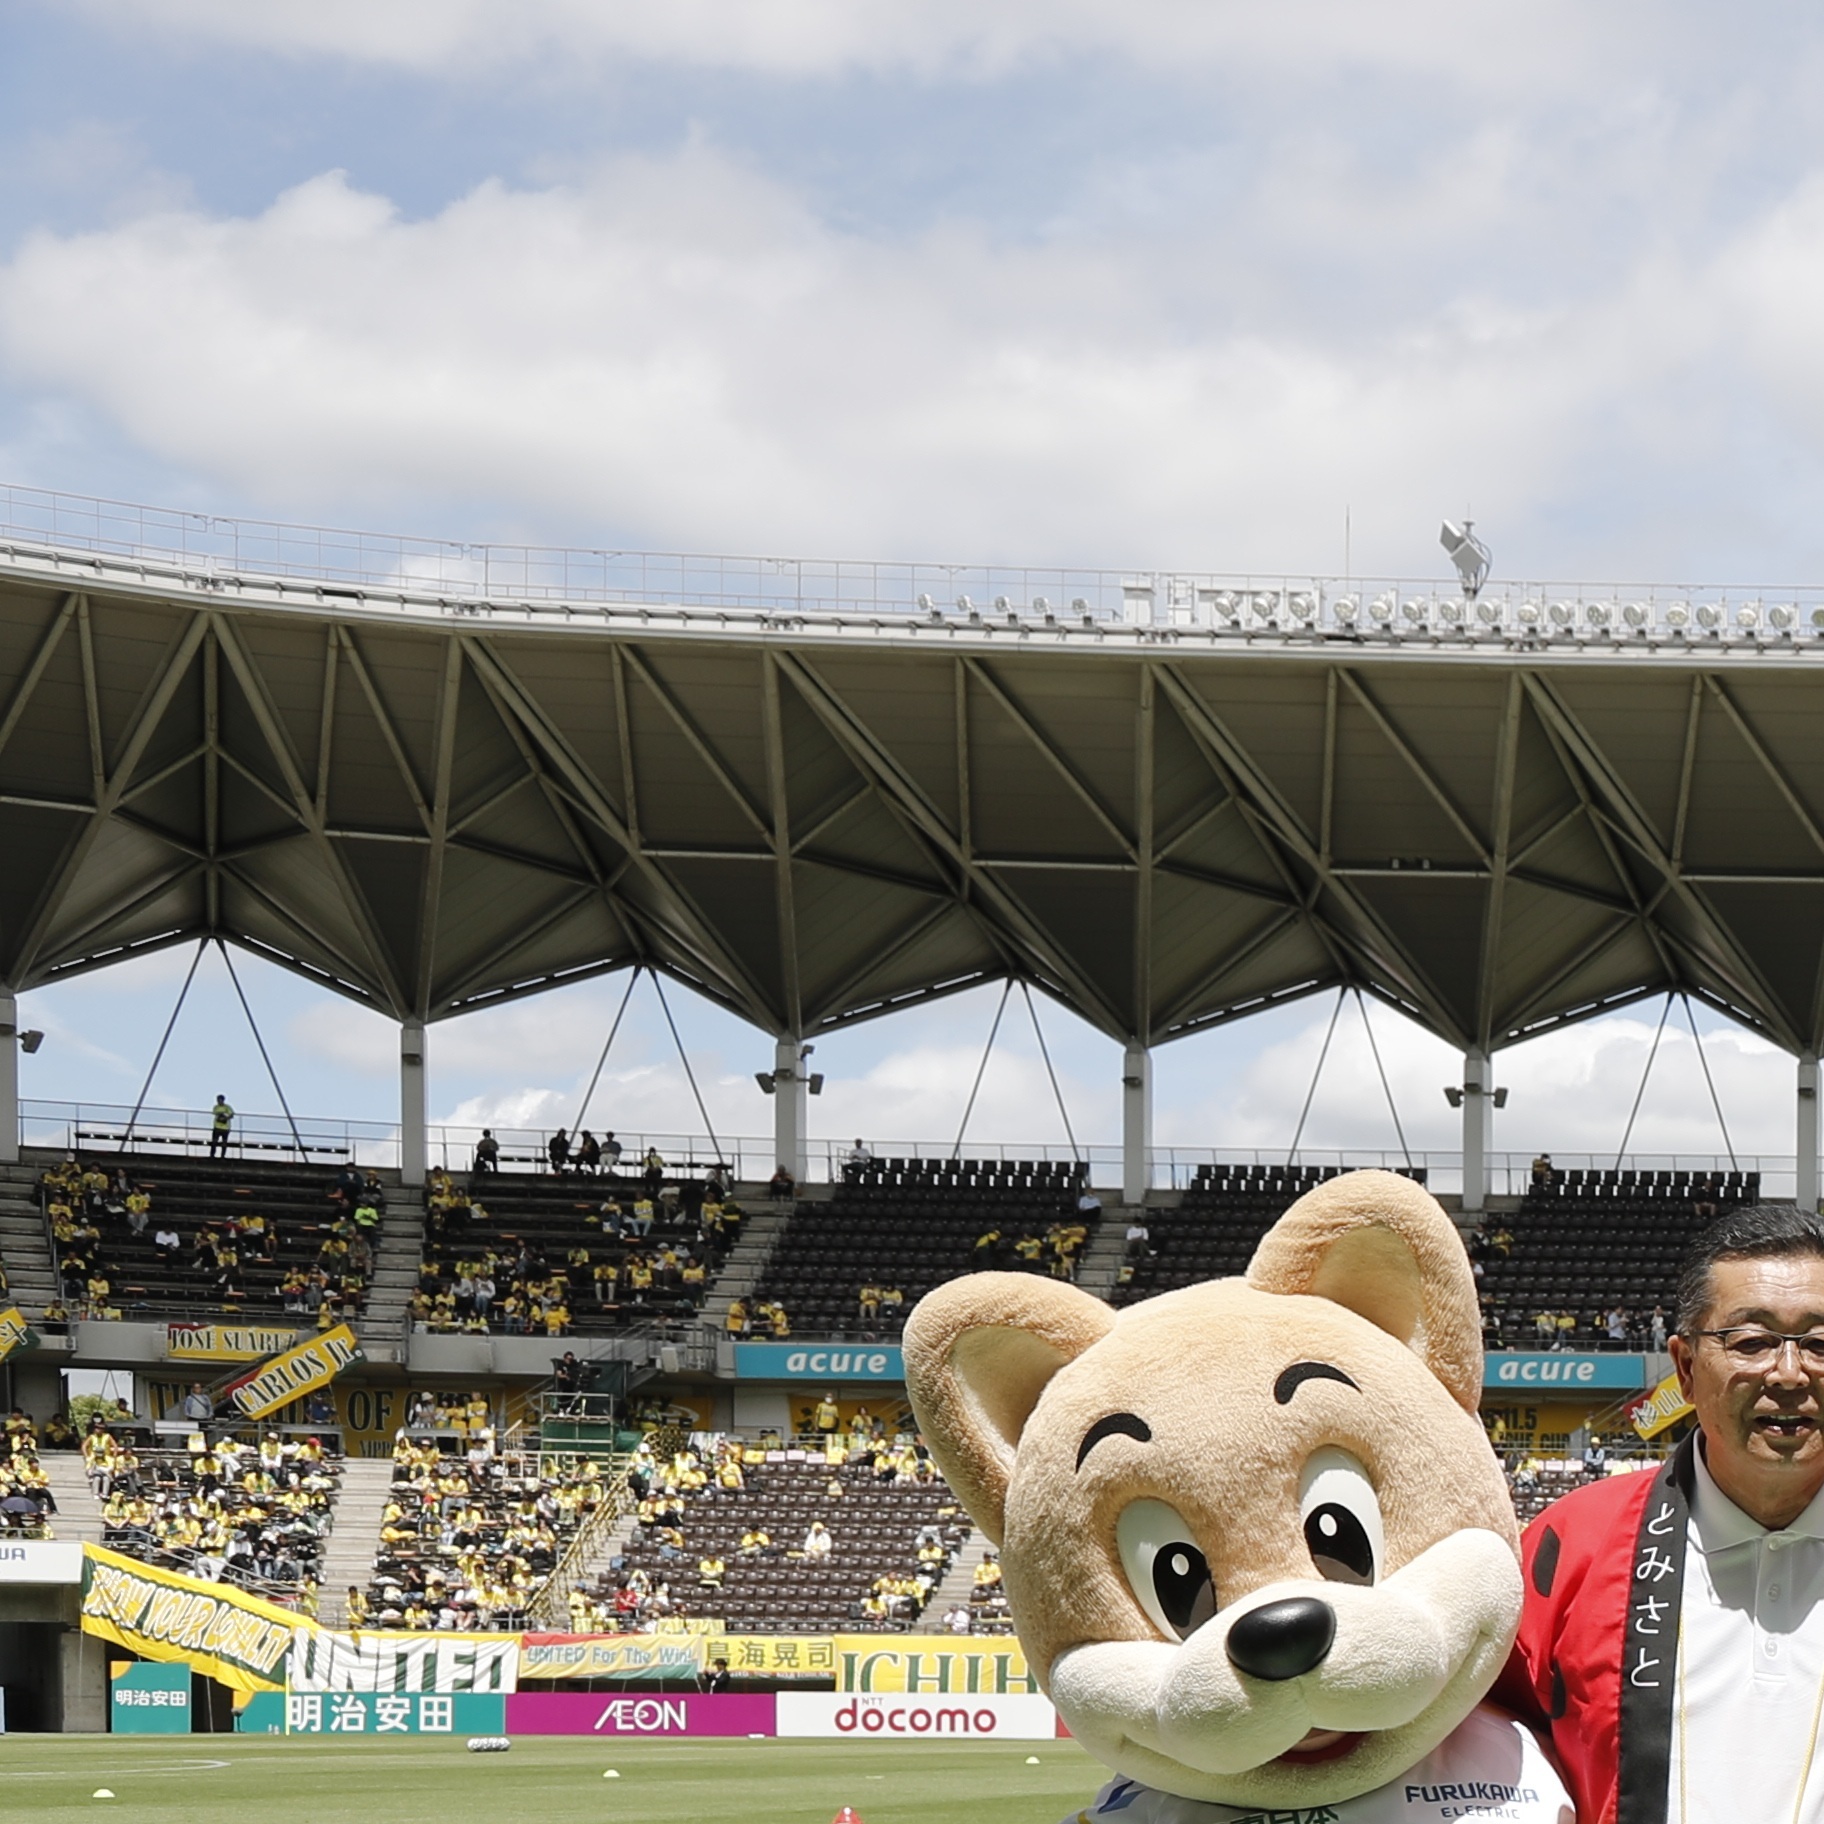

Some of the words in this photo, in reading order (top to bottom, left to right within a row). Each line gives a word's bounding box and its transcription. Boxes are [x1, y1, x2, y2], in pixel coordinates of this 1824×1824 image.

[232, 1348, 328, 1416] CARLOS
[324, 1334, 363, 1374] Jr.
[786, 1352, 888, 1373] acure
[1498, 1360, 1596, 1382] acure
[347, 1389, 395, 1432] OF
[1631, 1501, 1677, 1690] とみさと
[142, 1586, 217, 1649] YOUR
[293, 1627, 519, 1694] UNITED
[526, 1644, 587, 1664] UNITED
[591, 1645, 617, 1664] For
[624, 1645, 651, 1665] The
[658, 1644, 693, 1665] Win!
[838, 1650, 1042, 1694] ICHIH
[116, 1689, 187, 1708] 明治安田
[289, 1695, 453, 1733] 明治安田
[834, 1697, 997, 1733] docomo
[861, 1697, 884, 1706] NTT
[1405, 1782, 1541, 1803] FURUKAWA
[1440, 1804, 1521, 1819] ELECTRIC
